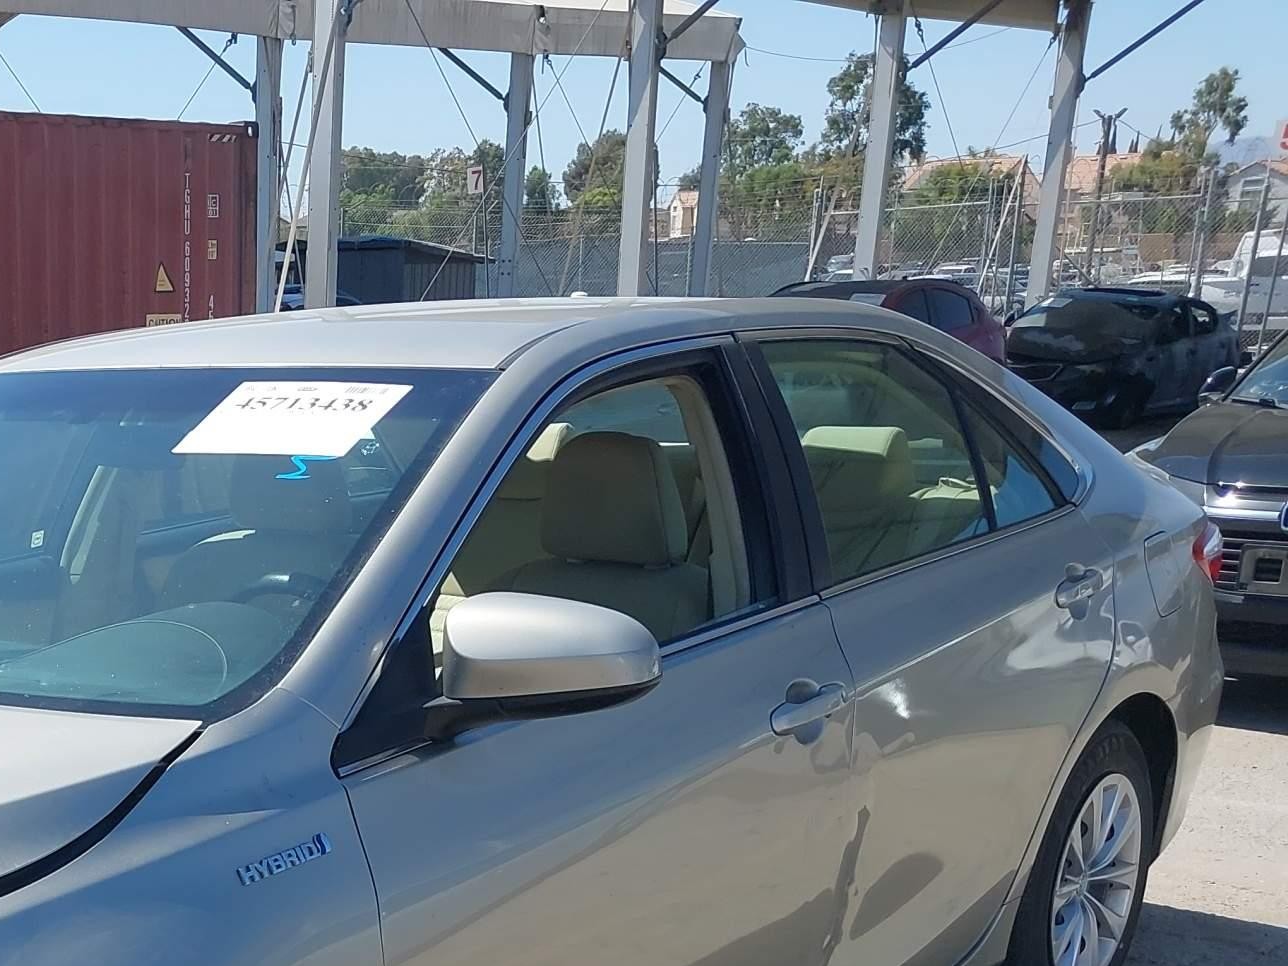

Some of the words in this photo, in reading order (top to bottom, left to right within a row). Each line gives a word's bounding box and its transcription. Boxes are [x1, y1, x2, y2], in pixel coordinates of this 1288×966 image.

[472, 170, 481, 190] 7
[235, 397, 373, 411] 45713438
[237, 842, 321, 886] HYBRID
